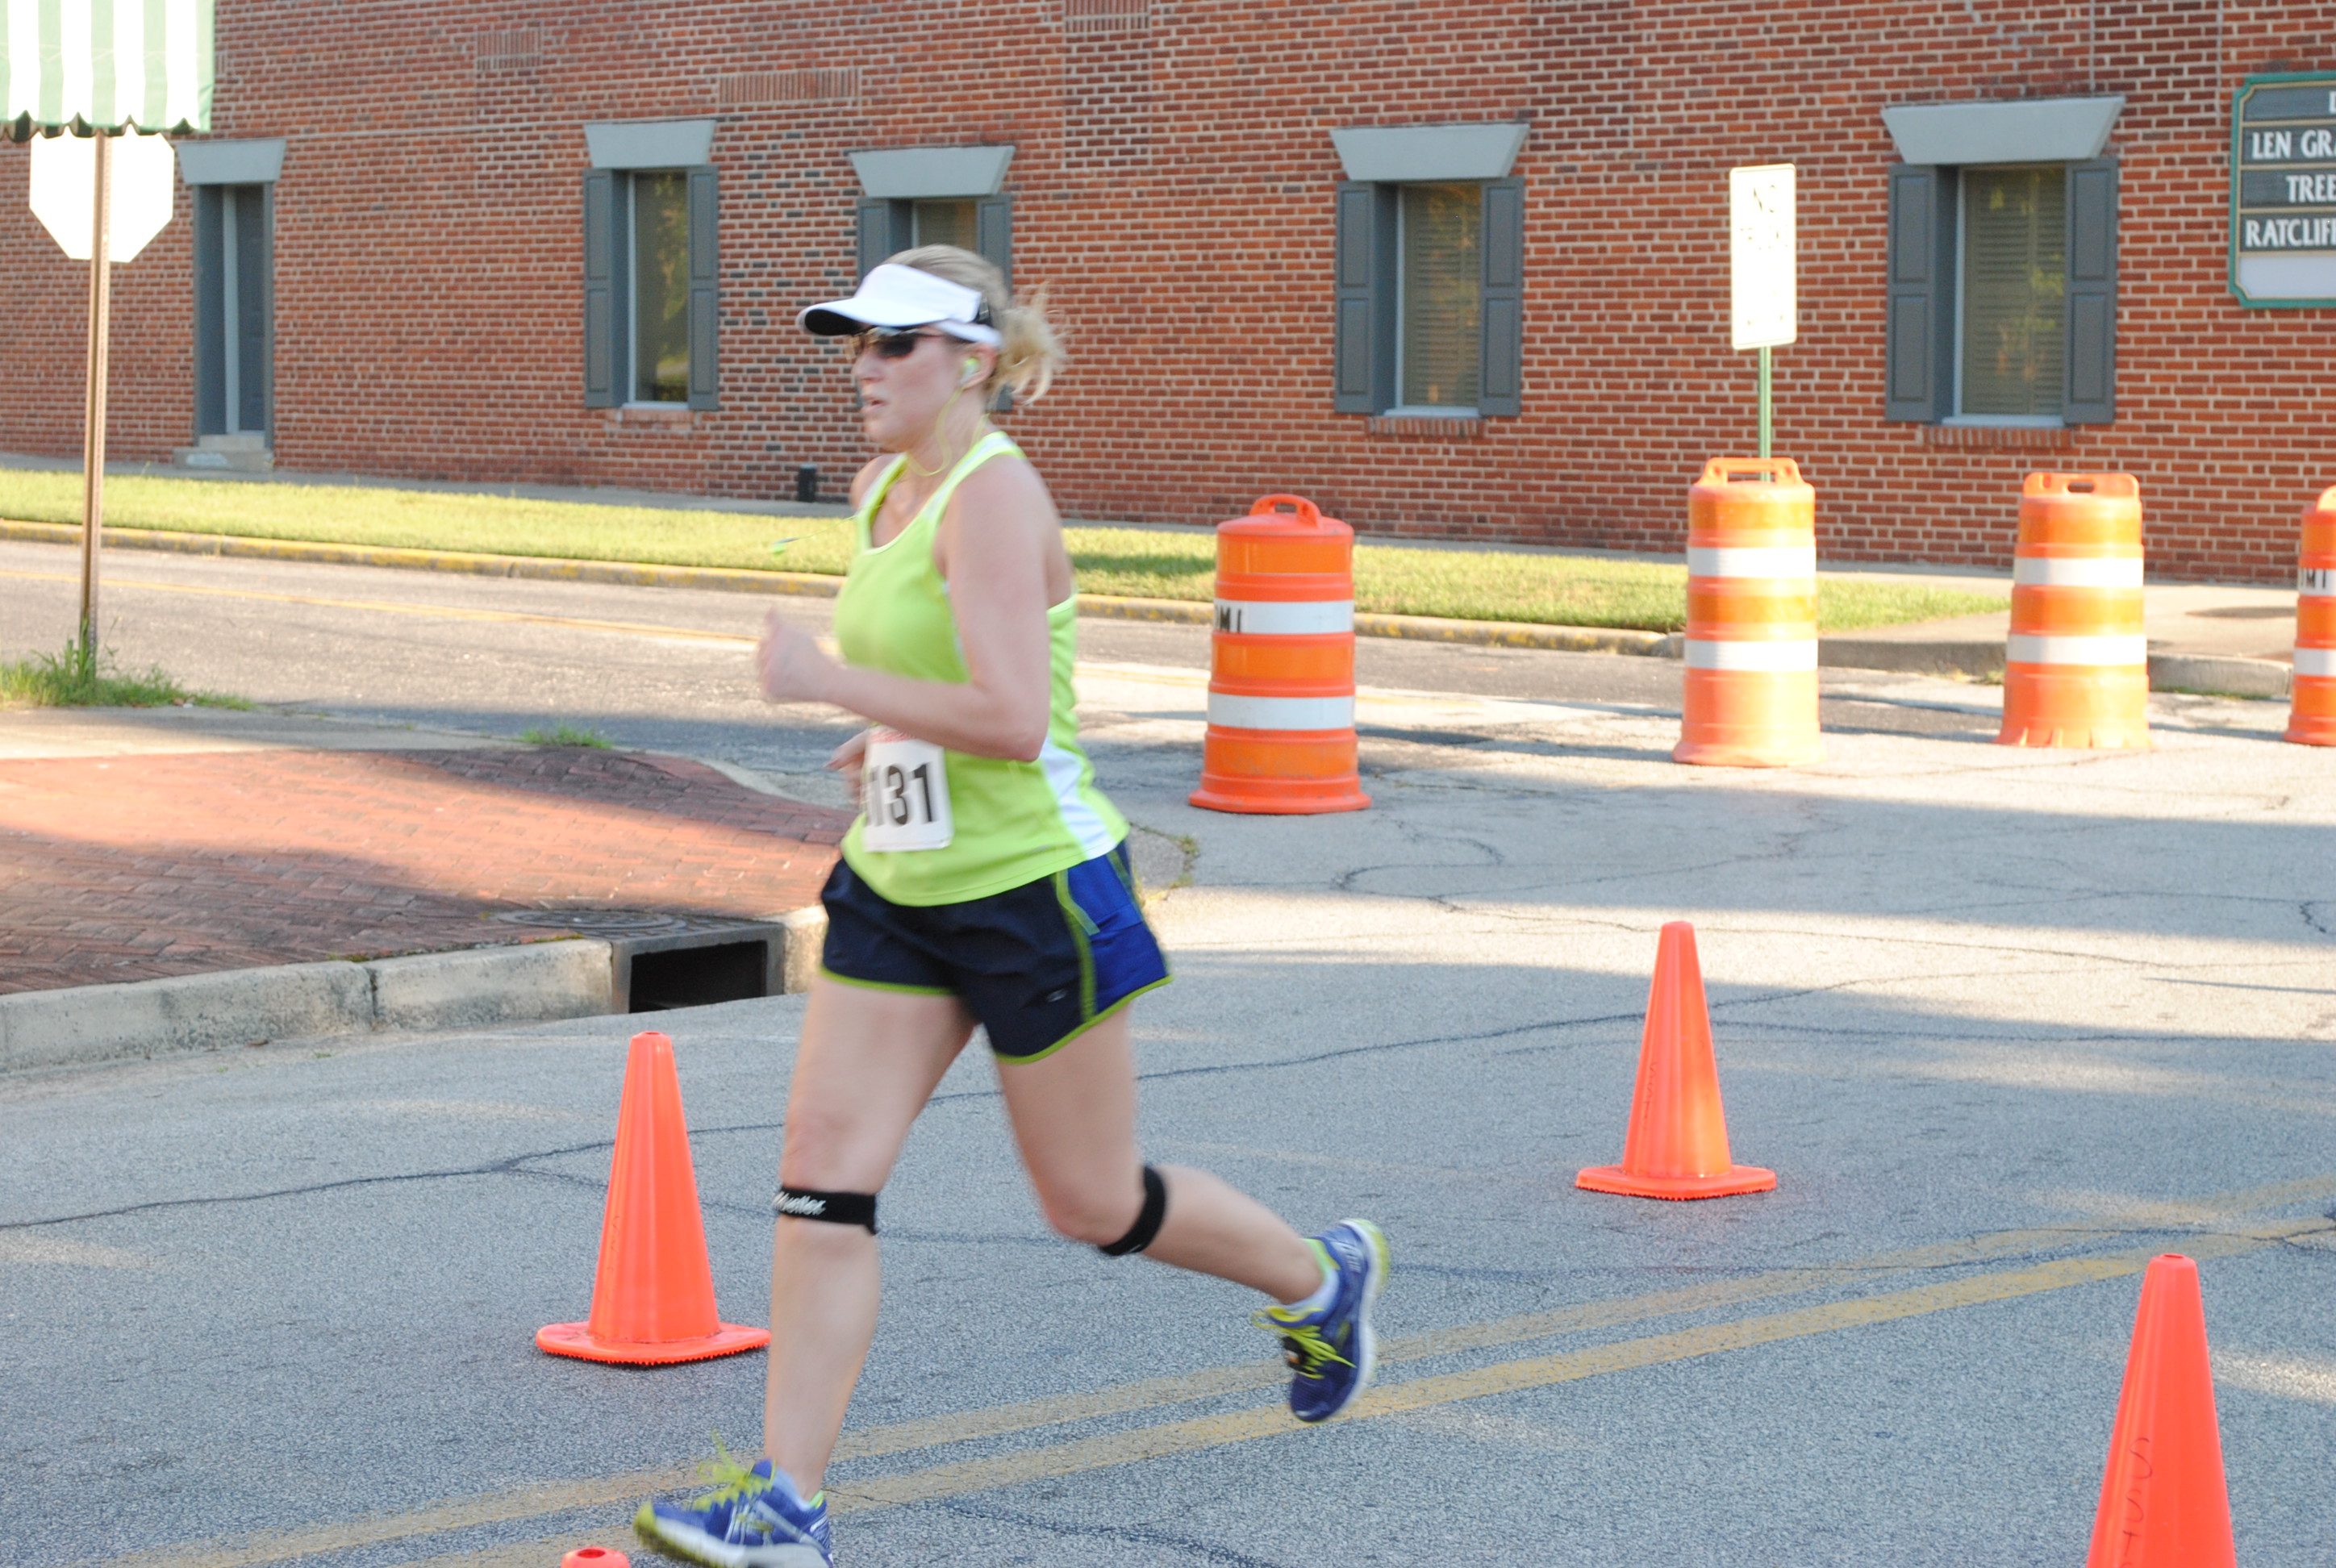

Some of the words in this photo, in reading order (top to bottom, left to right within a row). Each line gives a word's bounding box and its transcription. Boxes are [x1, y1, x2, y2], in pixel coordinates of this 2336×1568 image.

[2252, 131, 2292, 159] LEN
[2301, 129, 2336, 158] GR
[2285, 174, 2336, 202] TREE
